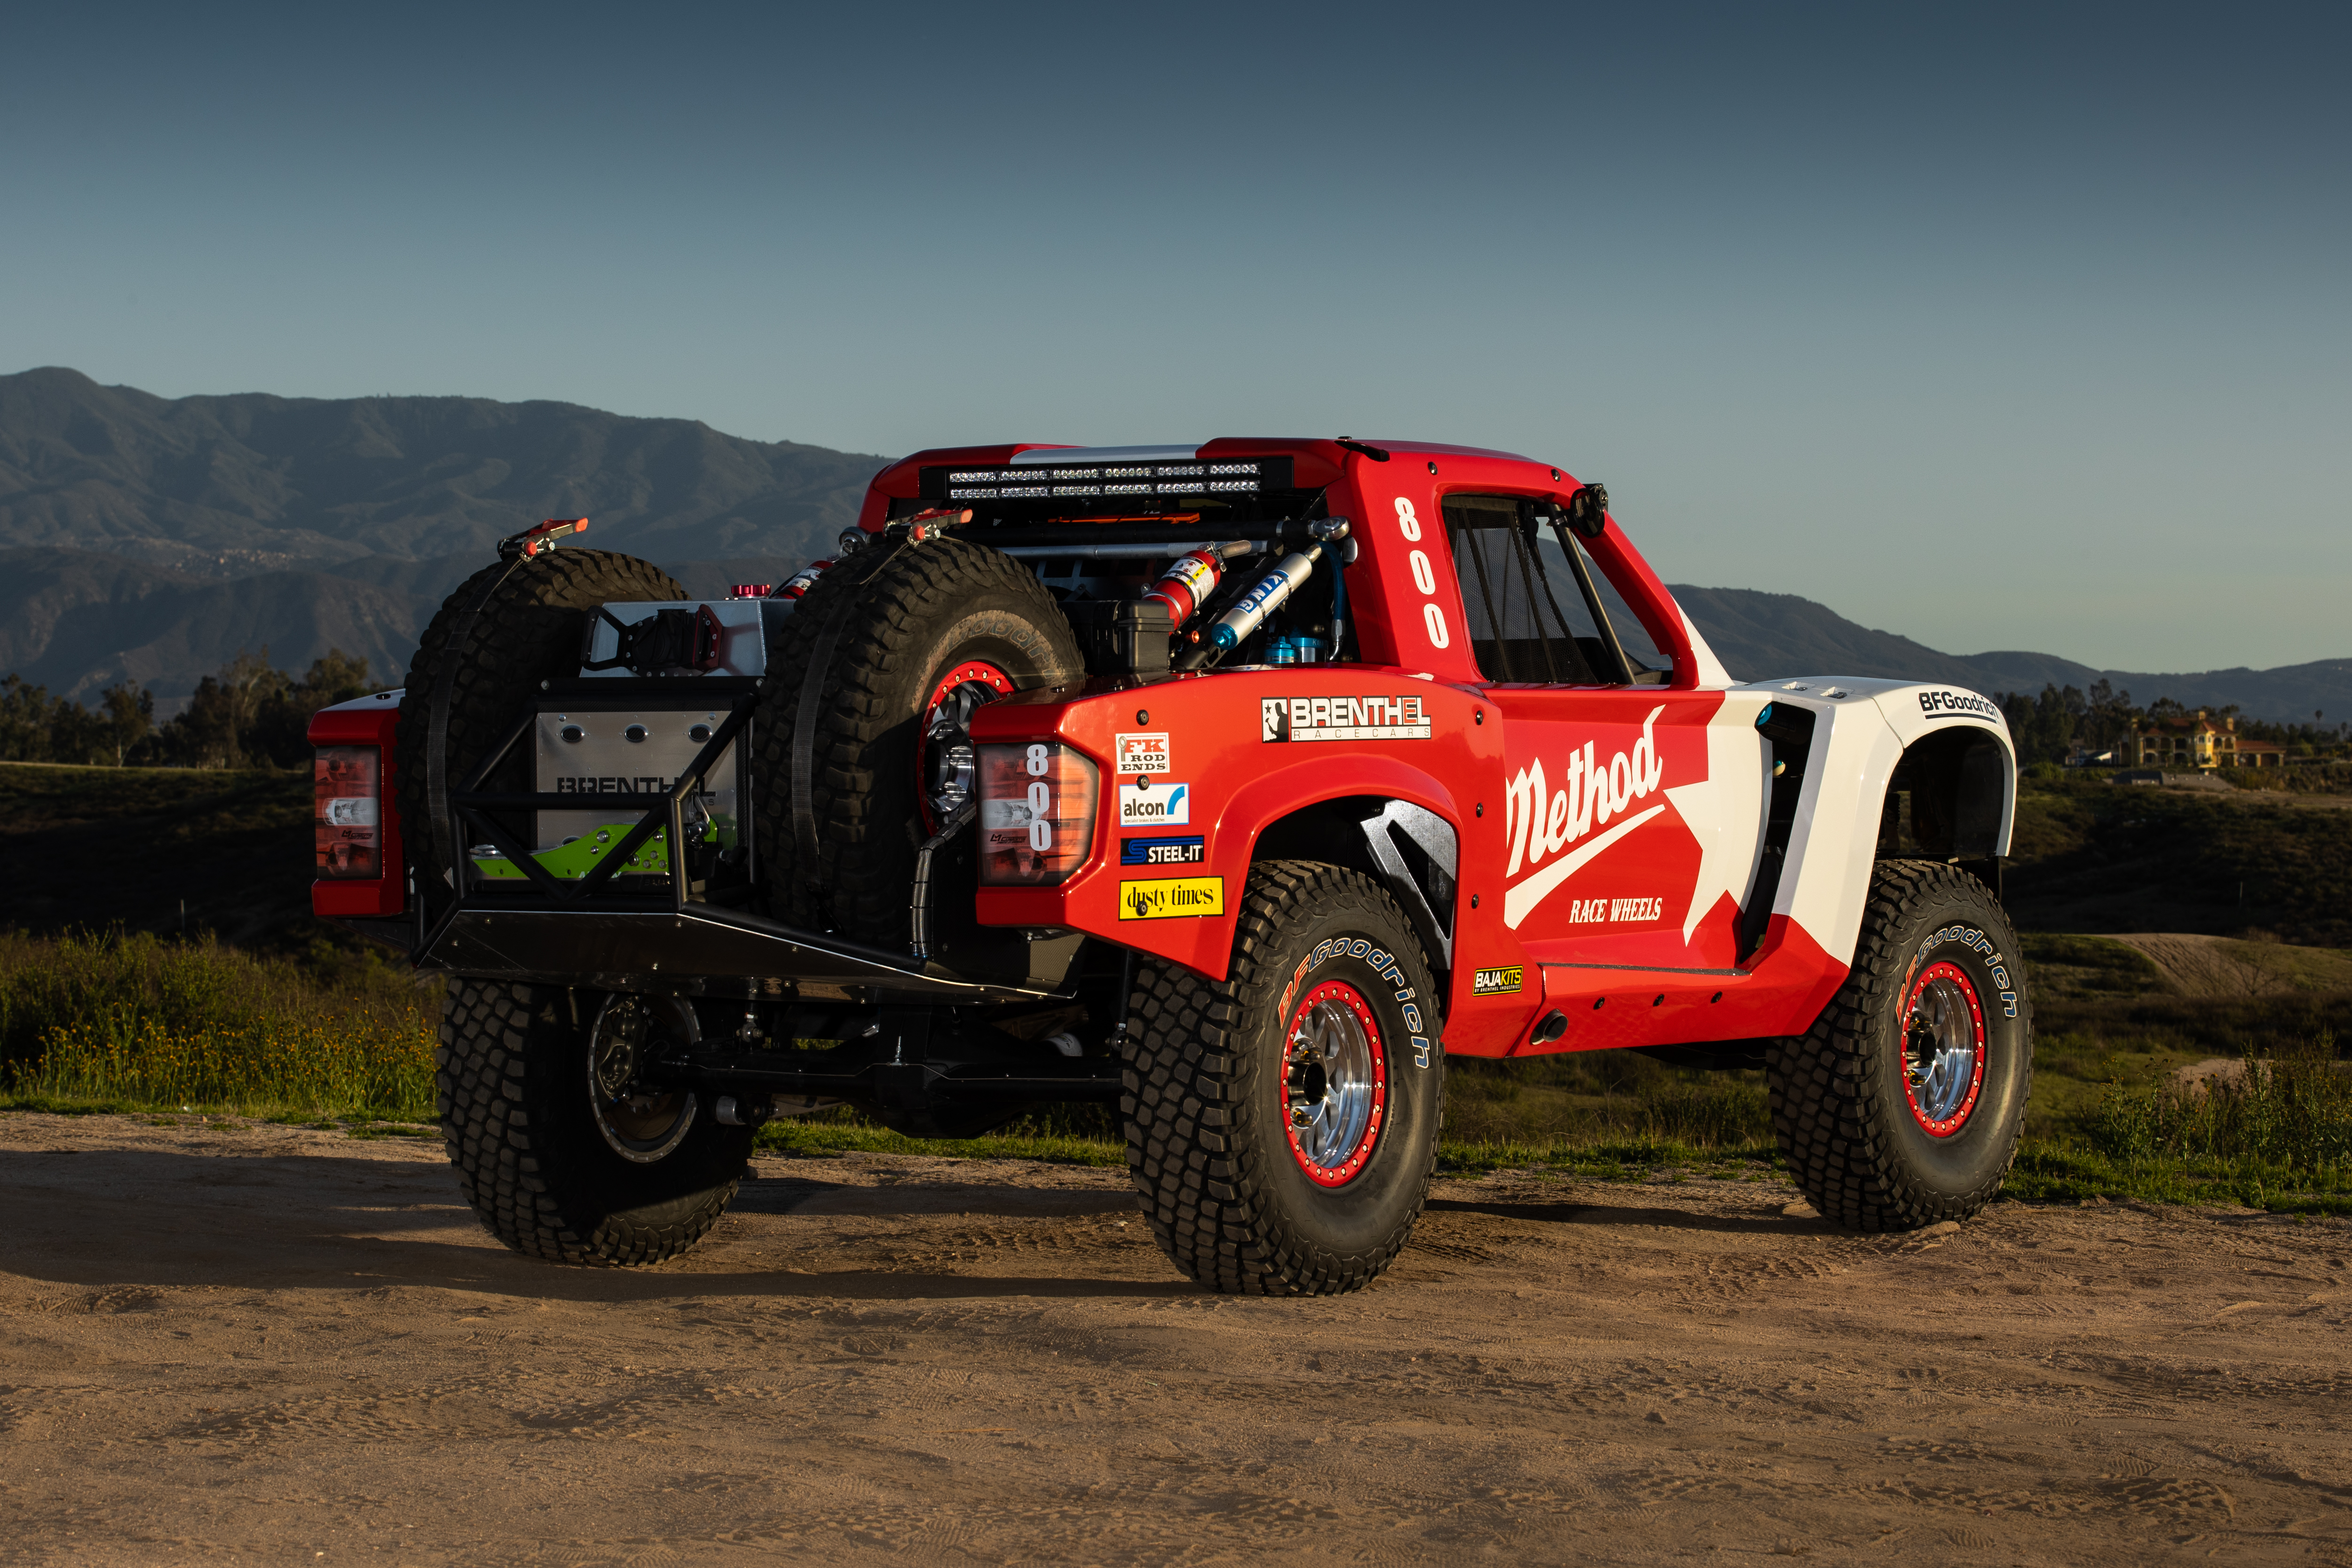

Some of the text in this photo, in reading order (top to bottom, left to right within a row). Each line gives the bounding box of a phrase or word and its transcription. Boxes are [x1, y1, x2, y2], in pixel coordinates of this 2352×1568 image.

[1395, 497, 1449, 649] 800
[1239, 575, 1283, 610] KING
[1290, 697, 1431, 728] BRENTHEL
[1919, 692, 1999, 718] BFGoodrich
[1125, 739, 1165, 753] FK
[1294, 727, 1429, 739] RACECARS
[557, 777, 716, 796] BRENTHL
[1027, 744, 1051, 851] 800
[1506, 704, 1666, 878] Method
[1124, 798, 1164, 816] alcon
[1171, 884, 1214, 906] times
[1569, 897, 1663, 923] RACE WHEELS
[1475, 969, 1521, 988] BAJAKITS
[1896, 926, 2017, 1025] BFGoodrich
[1279, 938, 1430, 1069] BFGoodrich
